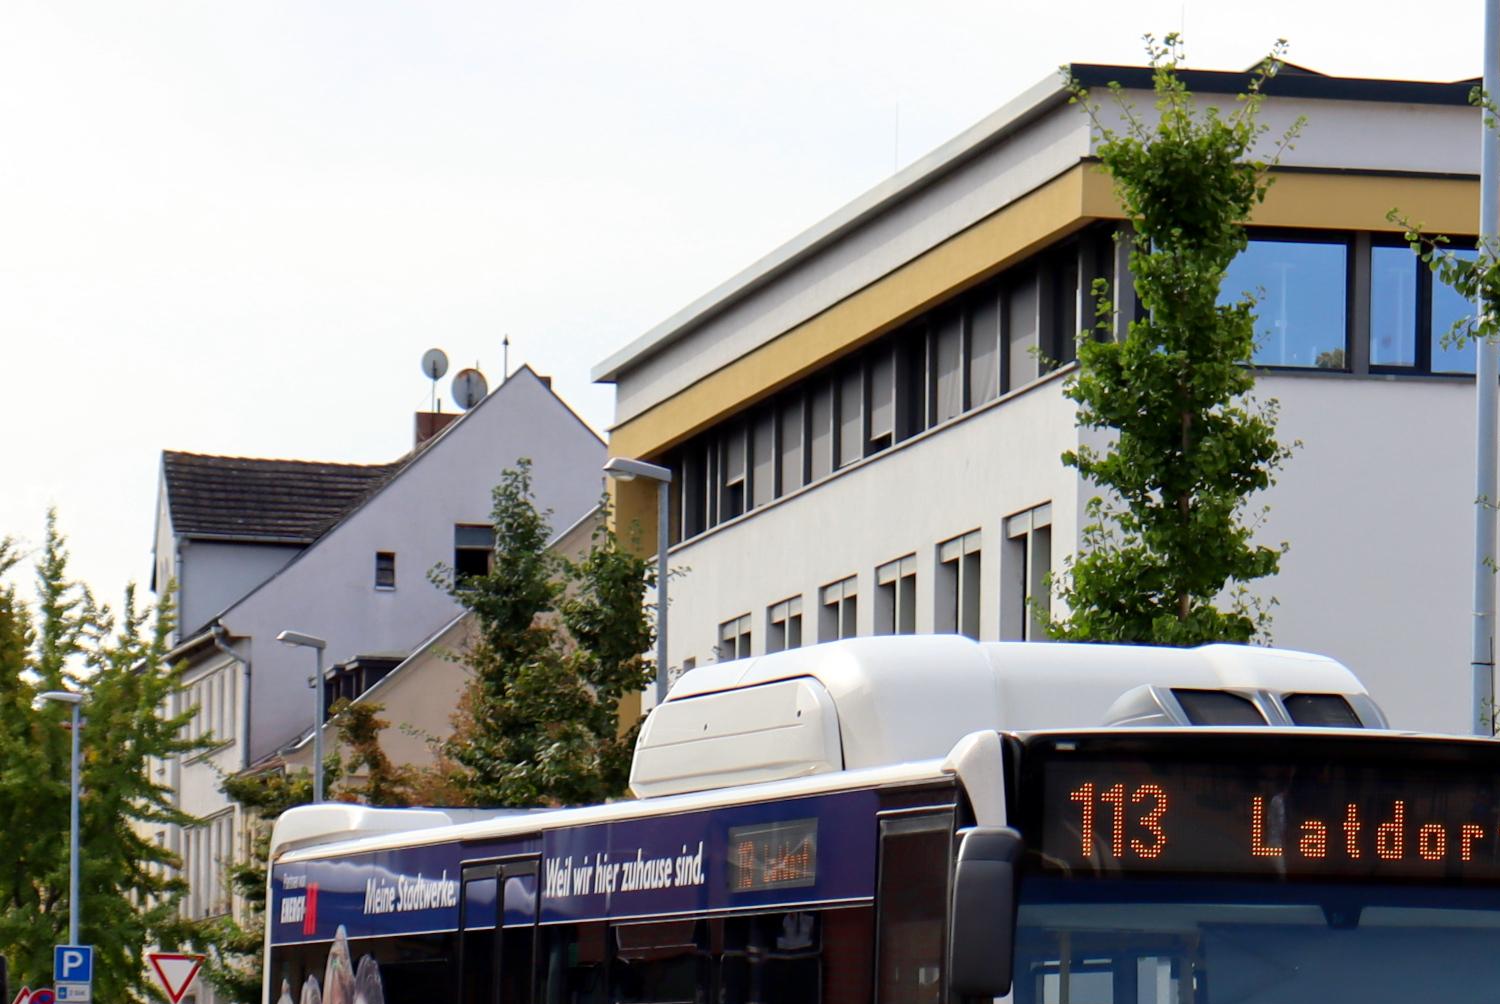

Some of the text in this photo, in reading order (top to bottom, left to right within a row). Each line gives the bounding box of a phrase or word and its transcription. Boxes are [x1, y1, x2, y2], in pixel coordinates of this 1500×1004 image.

[1070, 783, 1168, 859] 113
[364, 869, 456, 914] Meine Stadtwerke.
[545, 841, 705, 897] Weil wir hier zuhause sind.
[63, 951, 84, 977] P
